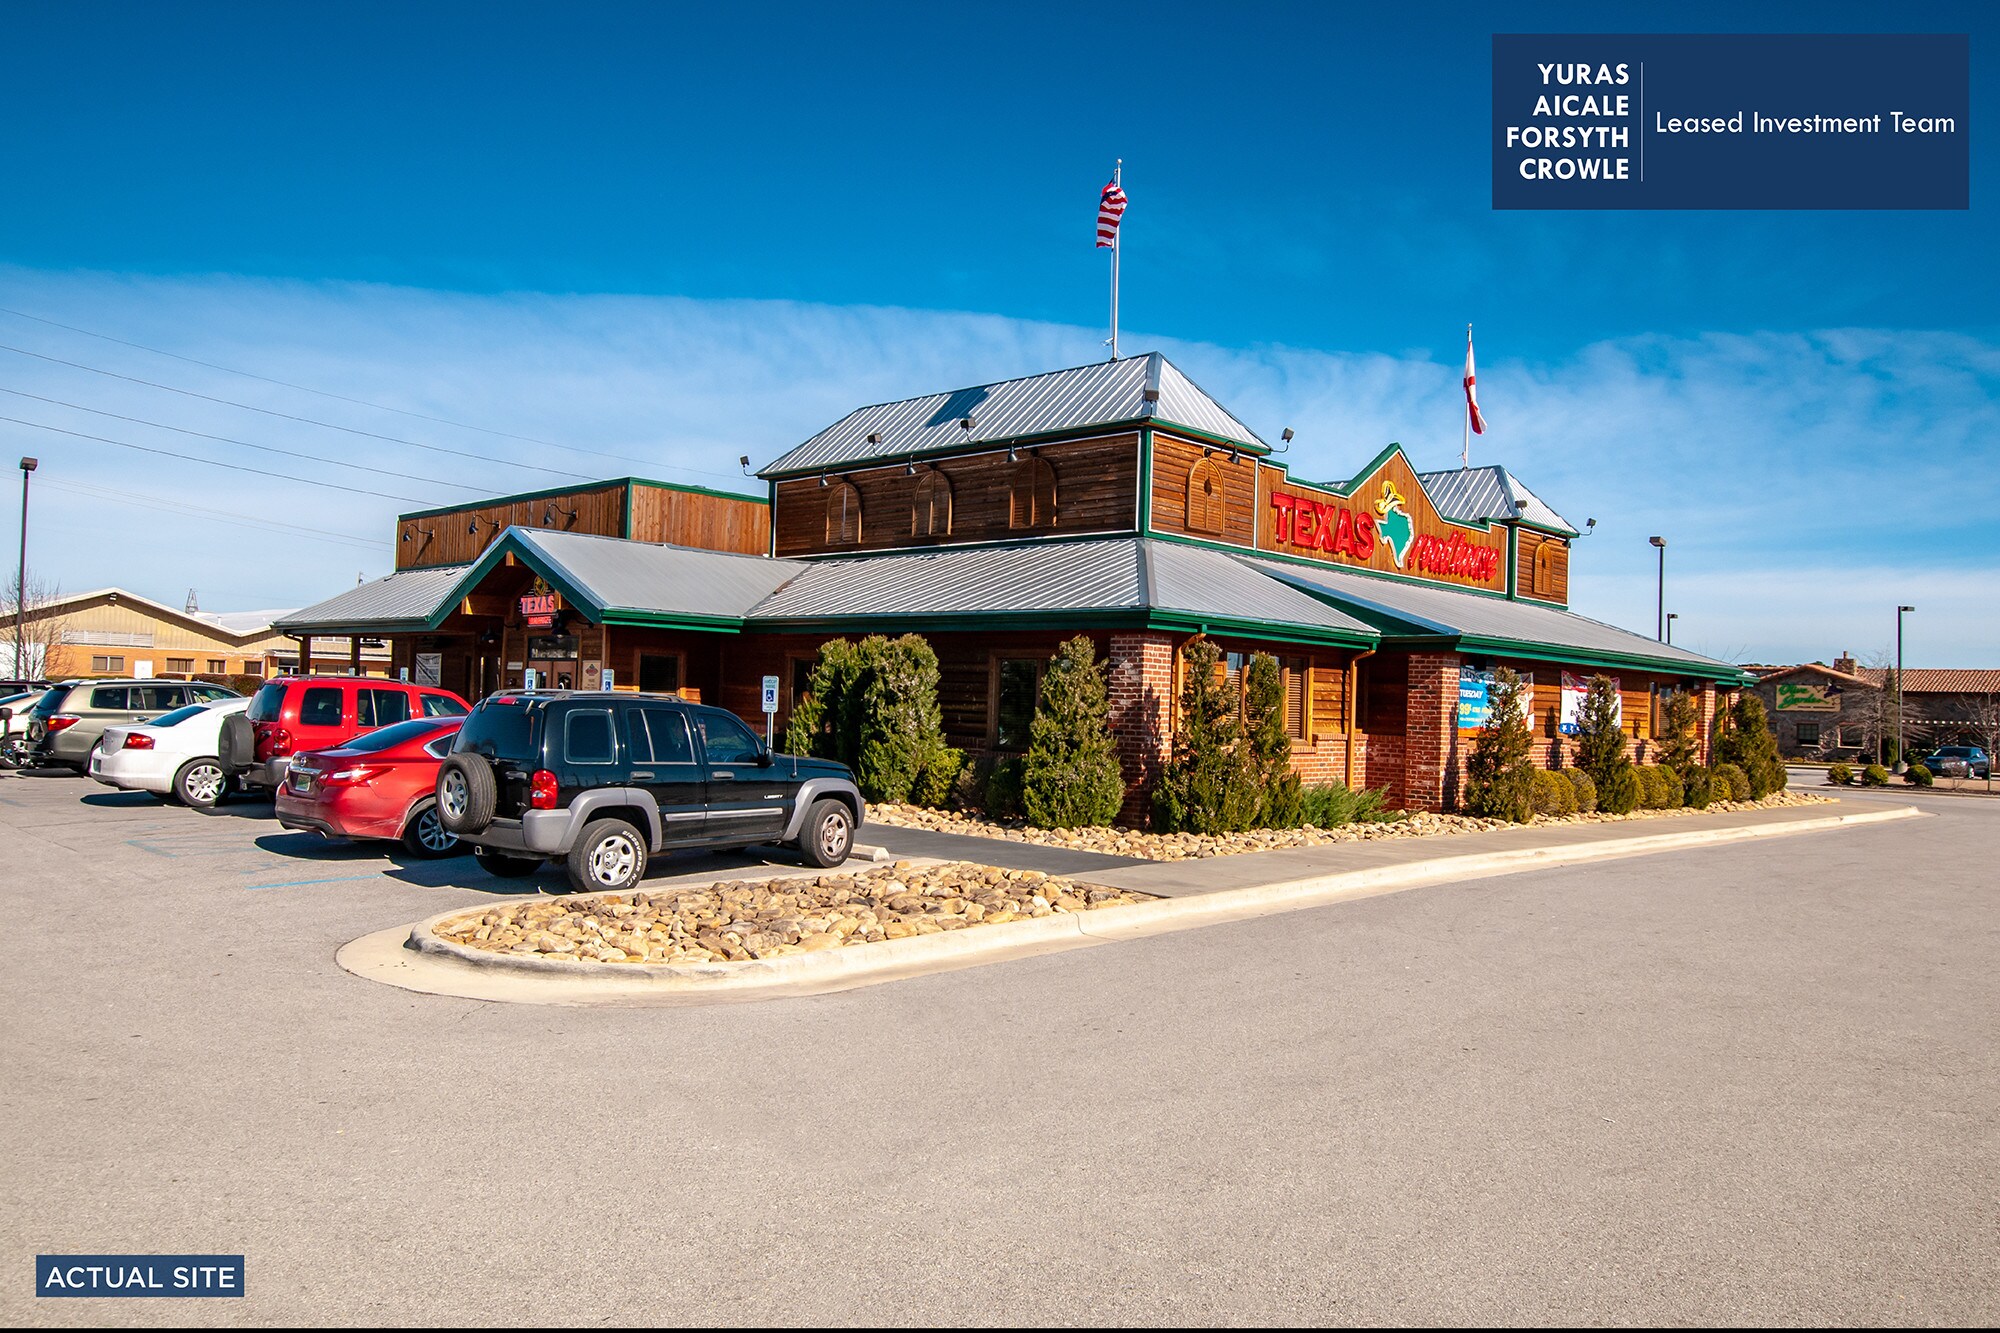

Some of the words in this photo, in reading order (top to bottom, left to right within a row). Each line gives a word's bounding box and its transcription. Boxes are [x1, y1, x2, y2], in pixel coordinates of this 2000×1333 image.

[1271, 492, 1375, 560] TEXAS
[521, 595, 555, 614] TEXAS
[1459, 688, 1483, 698] TUESDAY
